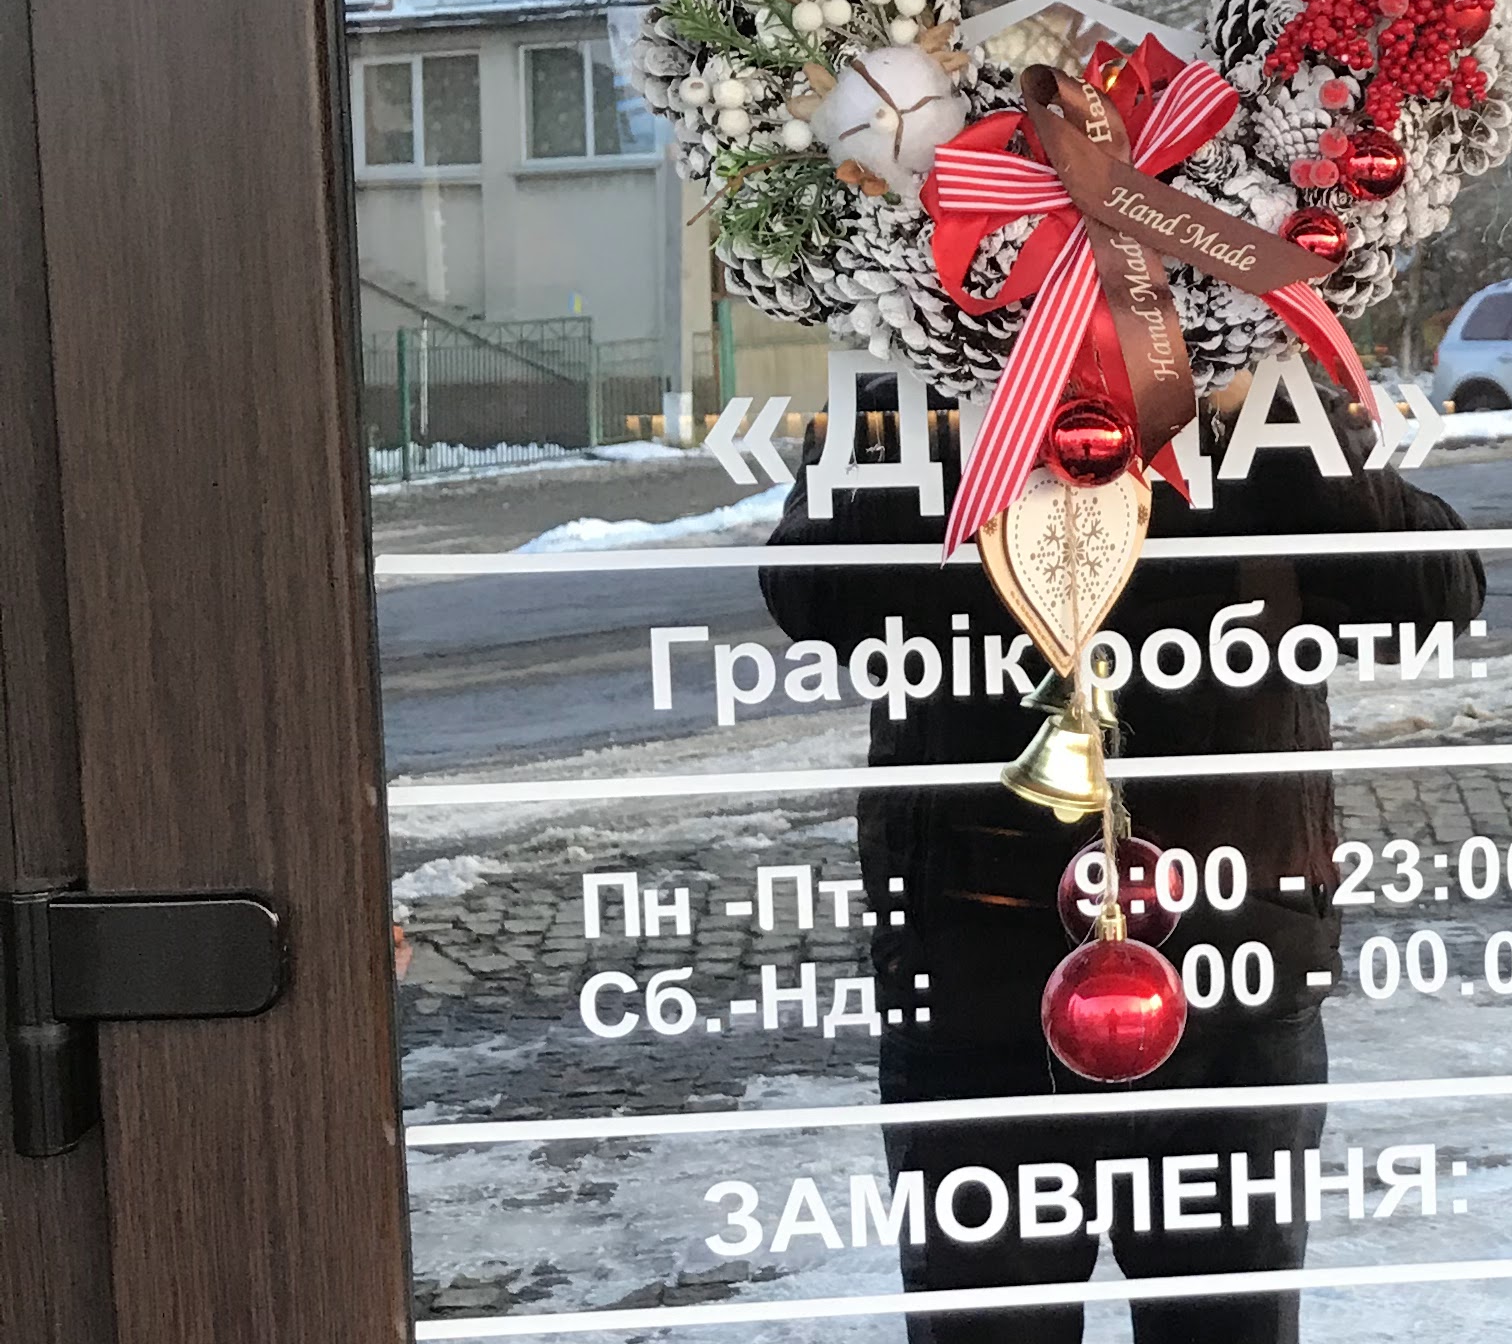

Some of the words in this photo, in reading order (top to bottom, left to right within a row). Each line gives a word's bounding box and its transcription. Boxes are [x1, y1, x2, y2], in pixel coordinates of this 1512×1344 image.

[1074, 76, 1113, 143] Han
[1103, 186, 1191, 236] Hand
[1179, 223, 1257, 272] Made
[1131, 305, 1180, 382] Hand
[649, 615, 1036, 726] Графік
[1081, 599, 1489, 714] роботи:
[1073, 846, 1248, 917] 9:00
[579, 962, 931, 1039] Сб.-Нд.:
[703, 1142, 1469, 1257] ЗАМОВЛЕННЯ:
